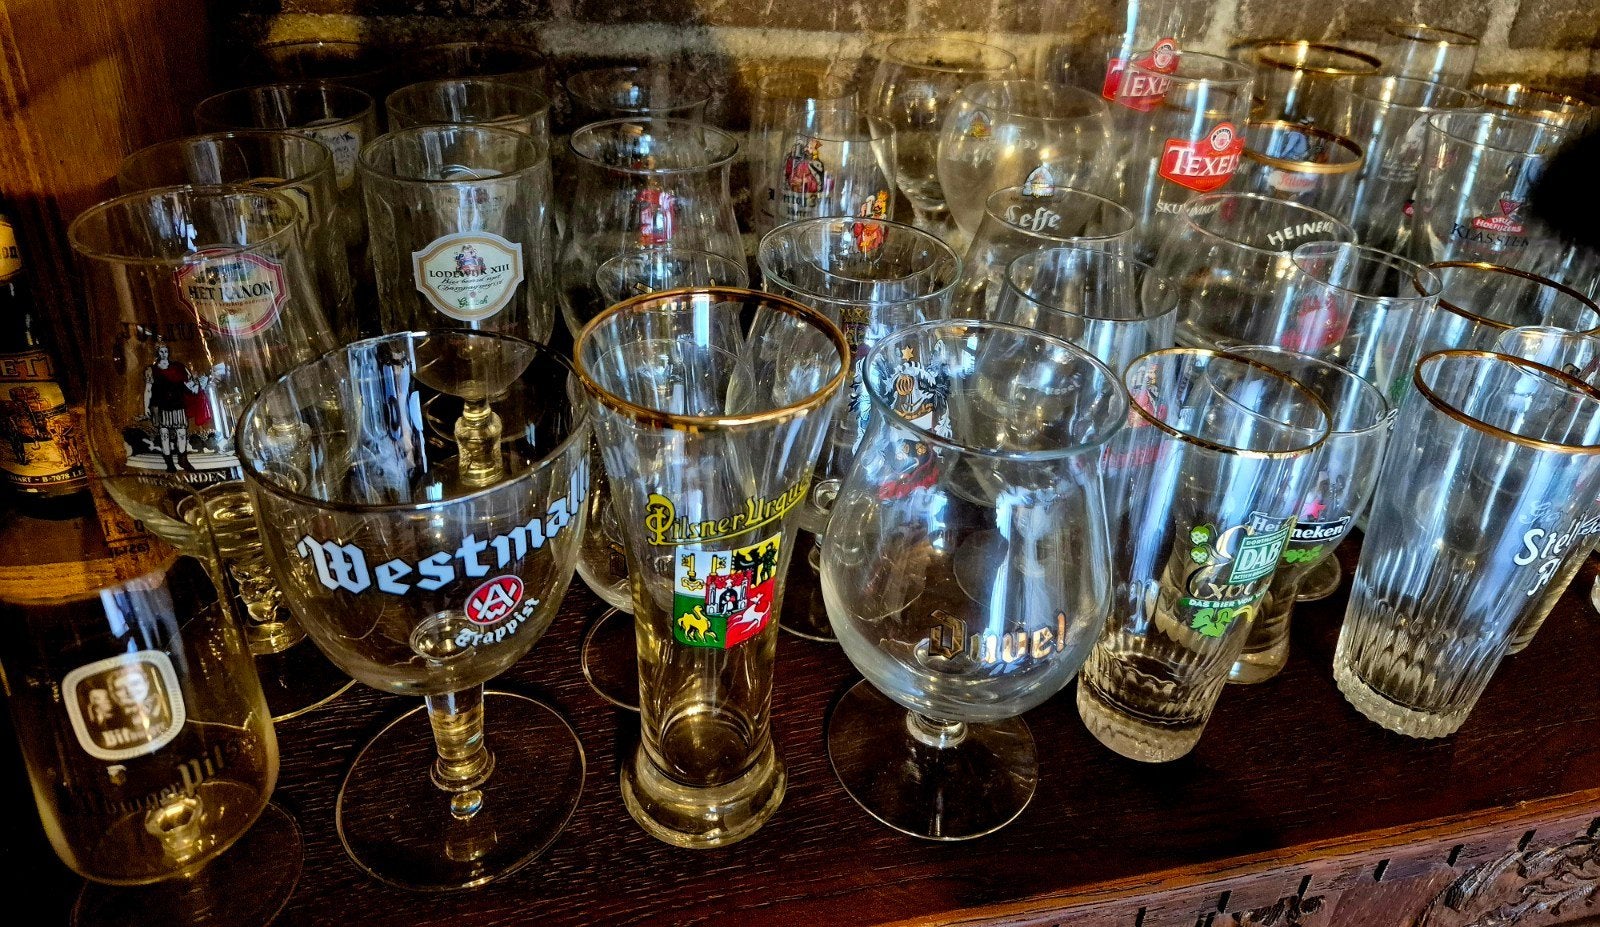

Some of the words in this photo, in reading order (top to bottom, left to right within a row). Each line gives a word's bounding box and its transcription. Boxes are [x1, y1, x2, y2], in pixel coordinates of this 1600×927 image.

[1004, 204, 1061, 232] Leffe
[490, 263, 510, 274] XIII
[189, 285, 215, 300] HET
[296, 457, 590, 595] Westmall
[644, 492, 746, 546] Pilsner
[1237, 541, 1283, 572] DAB
[1188, 598, 1210, 608] DAS
[1212, 600, 1235, 608] BIER
[454, 597, 540, 648] Trappist
[928, 608, 1067, 665] Duvel
